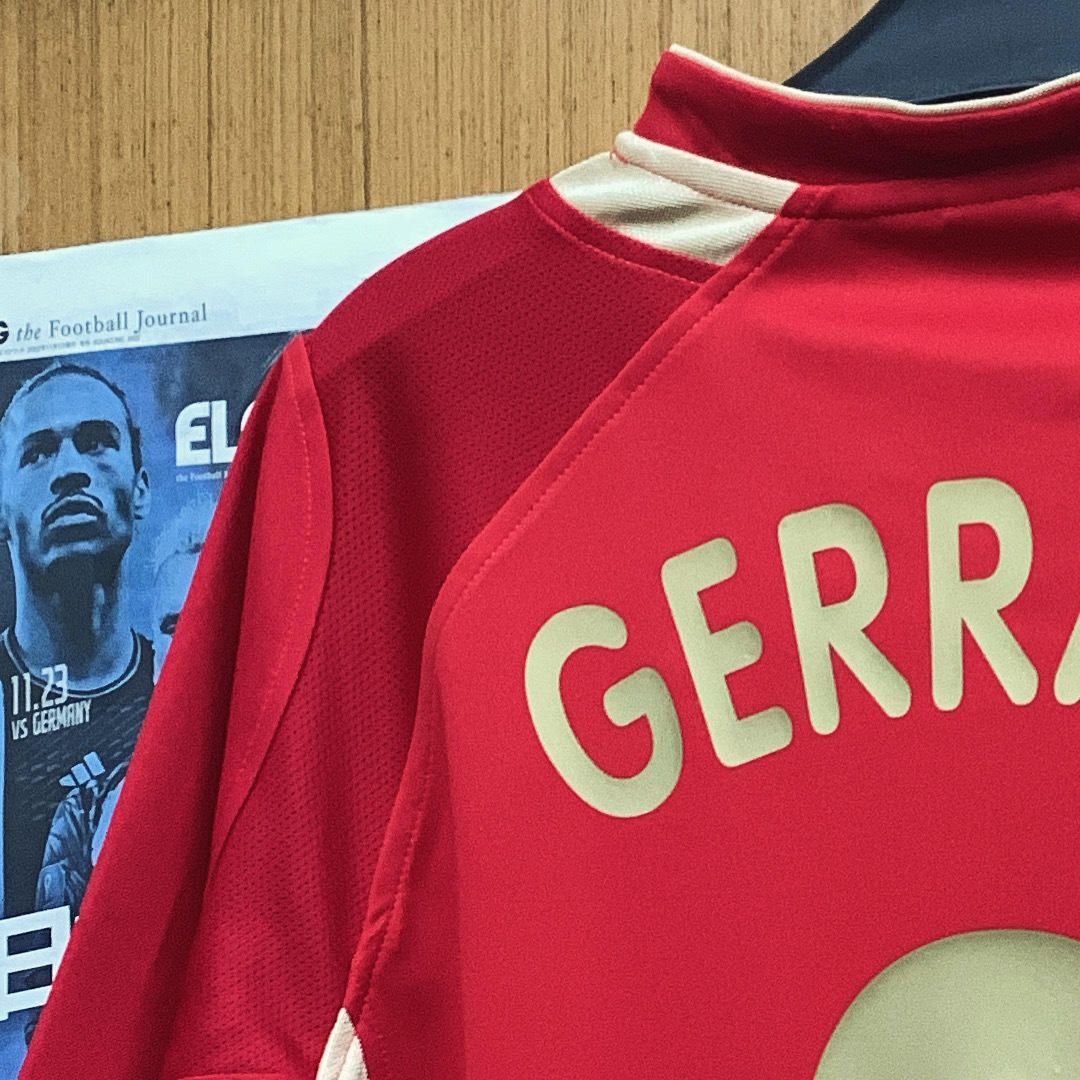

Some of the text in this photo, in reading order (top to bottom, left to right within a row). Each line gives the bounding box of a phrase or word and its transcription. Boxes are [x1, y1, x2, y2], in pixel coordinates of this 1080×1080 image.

[16, 322, 42, 342] the
[49, 311, 128, 338] Football
[133, 303, 207, 334] Journal
[175, 400, 256, 467] EL
[11, 663, 68, 715] 11.23
[11, 699, 91, 740] VS GERMANY
